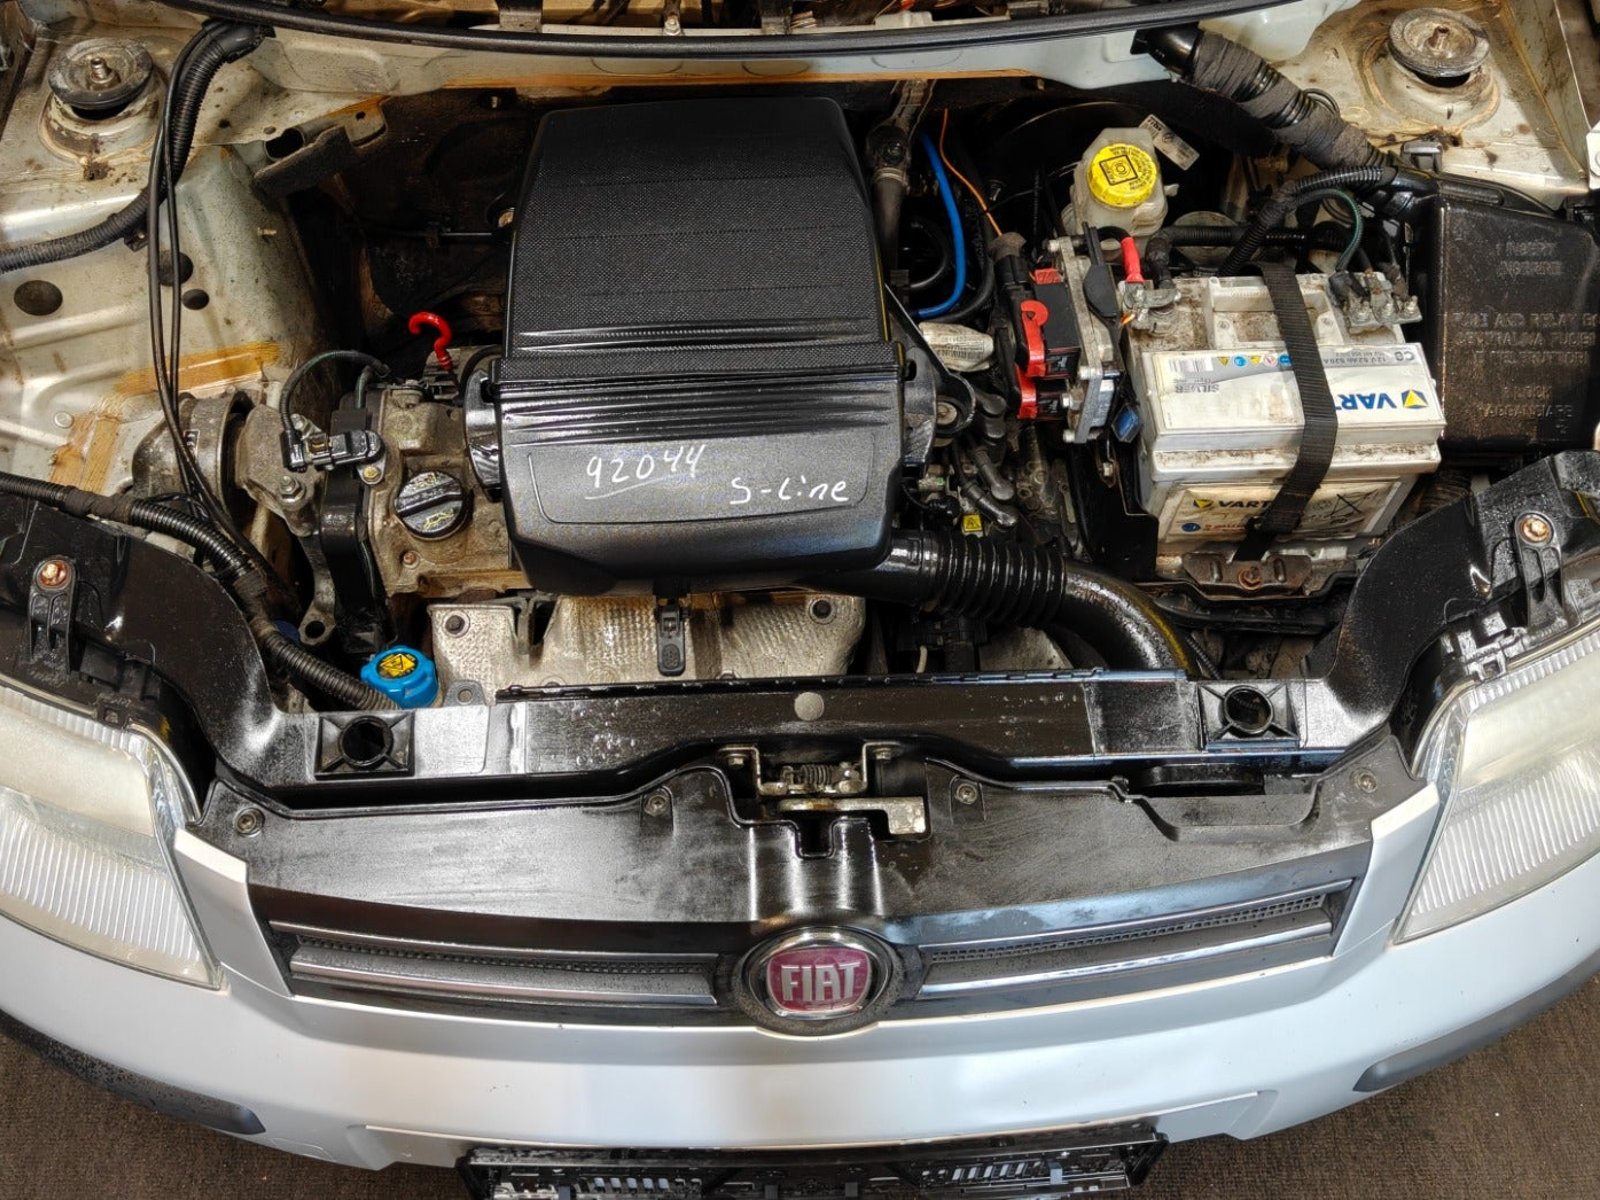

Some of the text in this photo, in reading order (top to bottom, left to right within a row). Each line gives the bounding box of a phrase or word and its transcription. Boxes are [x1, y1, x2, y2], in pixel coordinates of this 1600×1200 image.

[1334, 392, 1398, 411] VAR
[585, 444, 706, 488] 92044
[1218, 500, 1272, 509] VART
[781, 961, 861, 1001] FIAT
